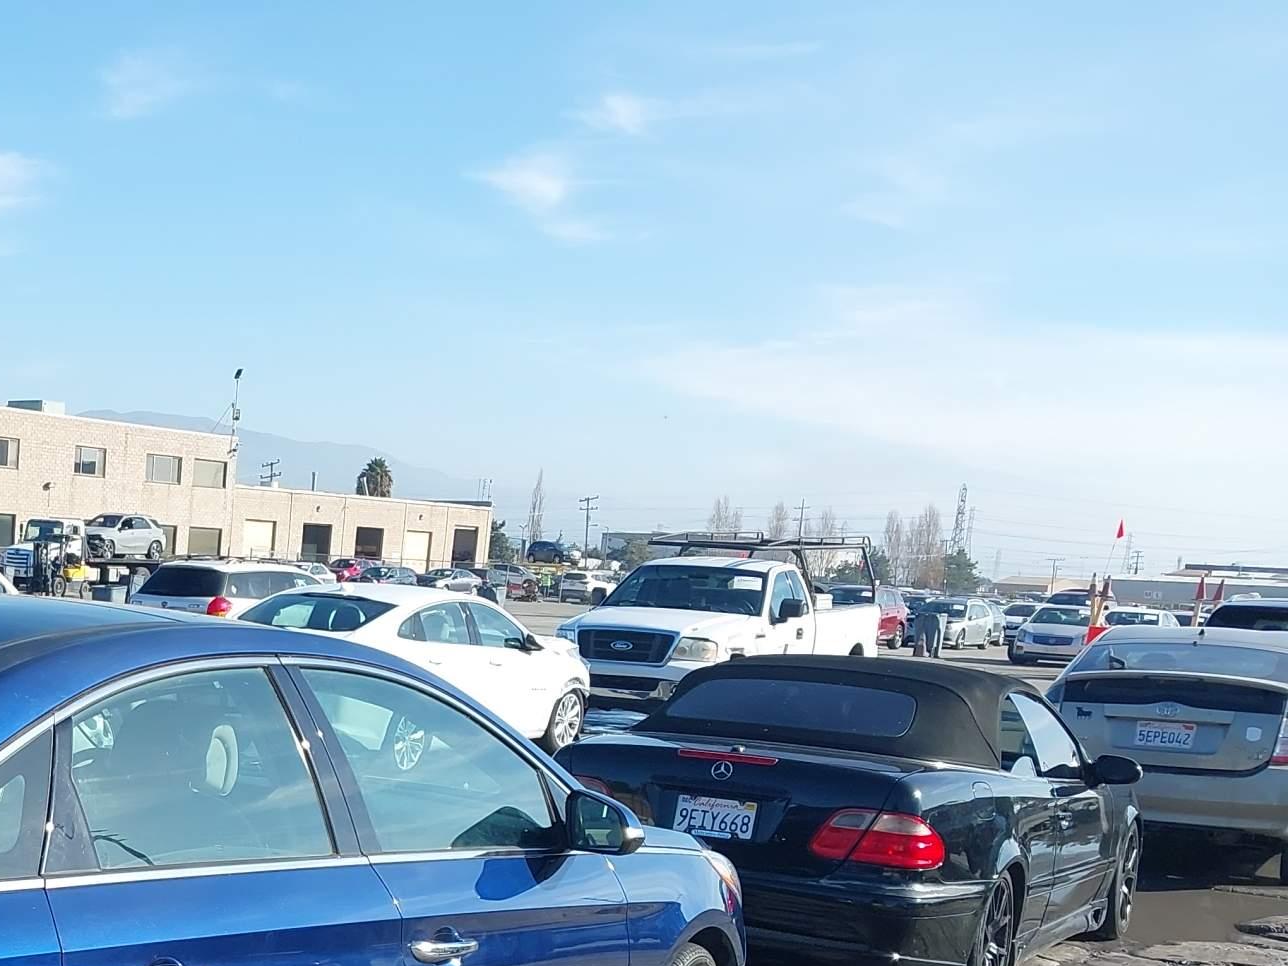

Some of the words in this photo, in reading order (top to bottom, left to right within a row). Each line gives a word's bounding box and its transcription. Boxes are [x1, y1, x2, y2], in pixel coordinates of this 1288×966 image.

[1137, 729, 1191, 746] 5EPE042
[693, 798, 742, 811] California
[676, 807, 751, 834] 9EIY668
